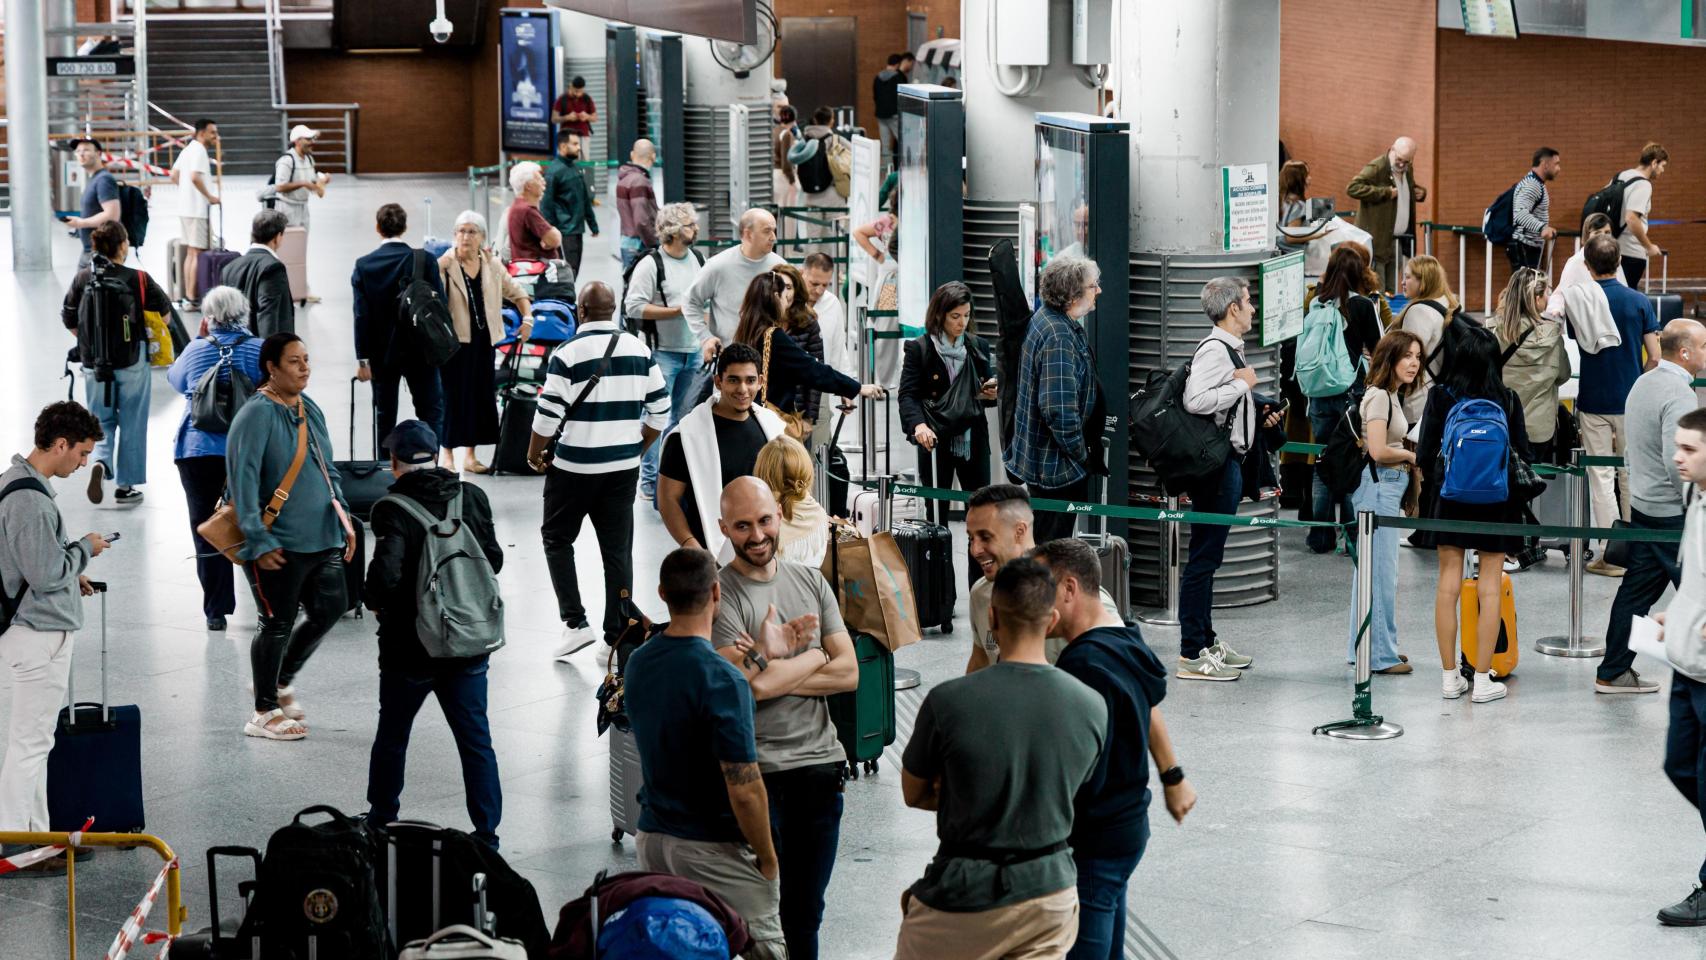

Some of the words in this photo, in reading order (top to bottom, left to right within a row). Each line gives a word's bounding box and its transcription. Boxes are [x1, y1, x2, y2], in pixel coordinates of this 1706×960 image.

[59, 64, 76, 73] 900
[79, 64, 95, 73] 730
[97, 64, 114, 73] 830
